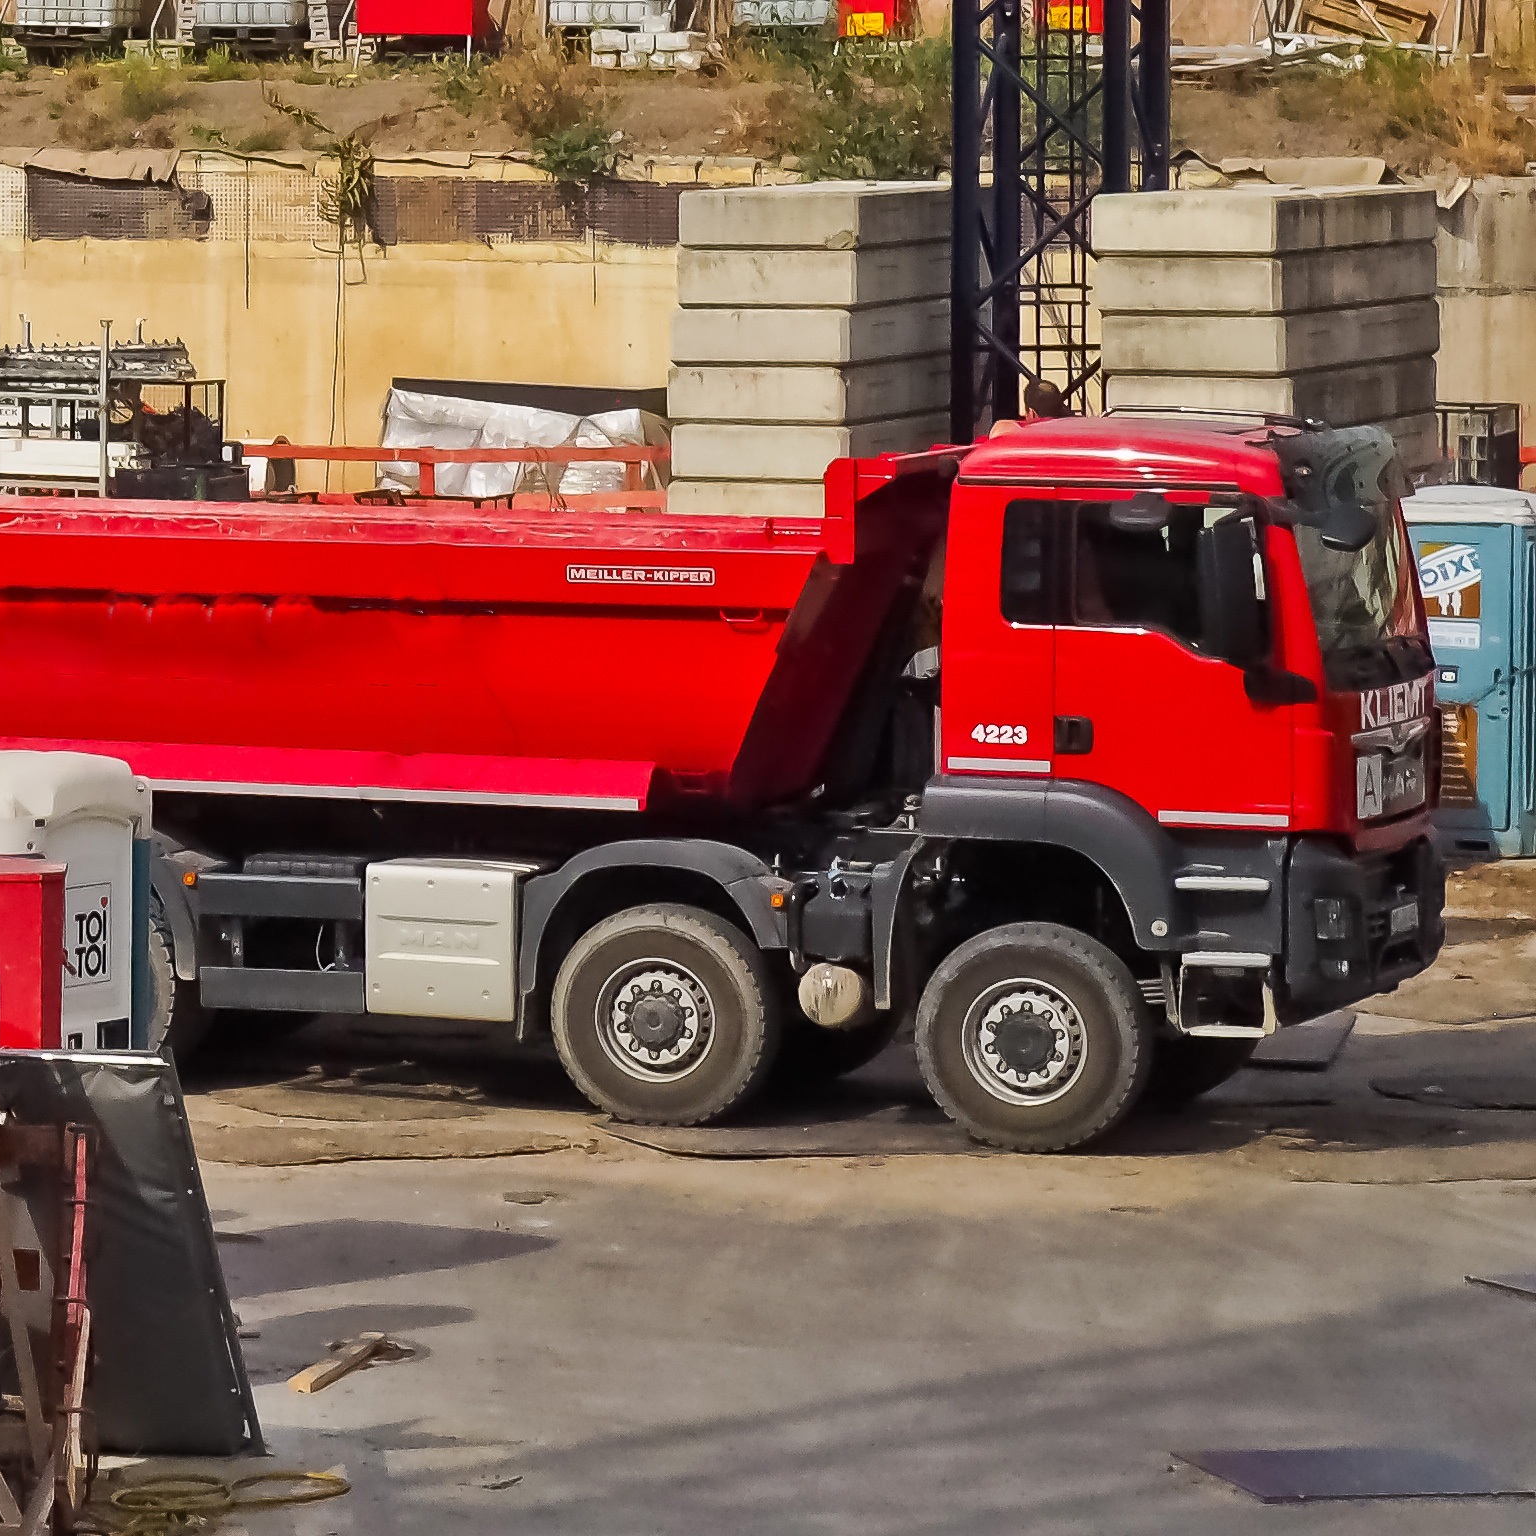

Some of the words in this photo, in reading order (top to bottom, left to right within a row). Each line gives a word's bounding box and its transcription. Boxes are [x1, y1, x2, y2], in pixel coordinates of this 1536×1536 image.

[570, 568, 711, 583] MEILLER-KIPPER
[1360, 678, 1429, 730] KLIEMT
[971, 723, 1028, 745] 4223
[1362, 763, 1378, 808] A
[74, 911, 107, 944] TOI
[74, 944, 107, 979] TOI
